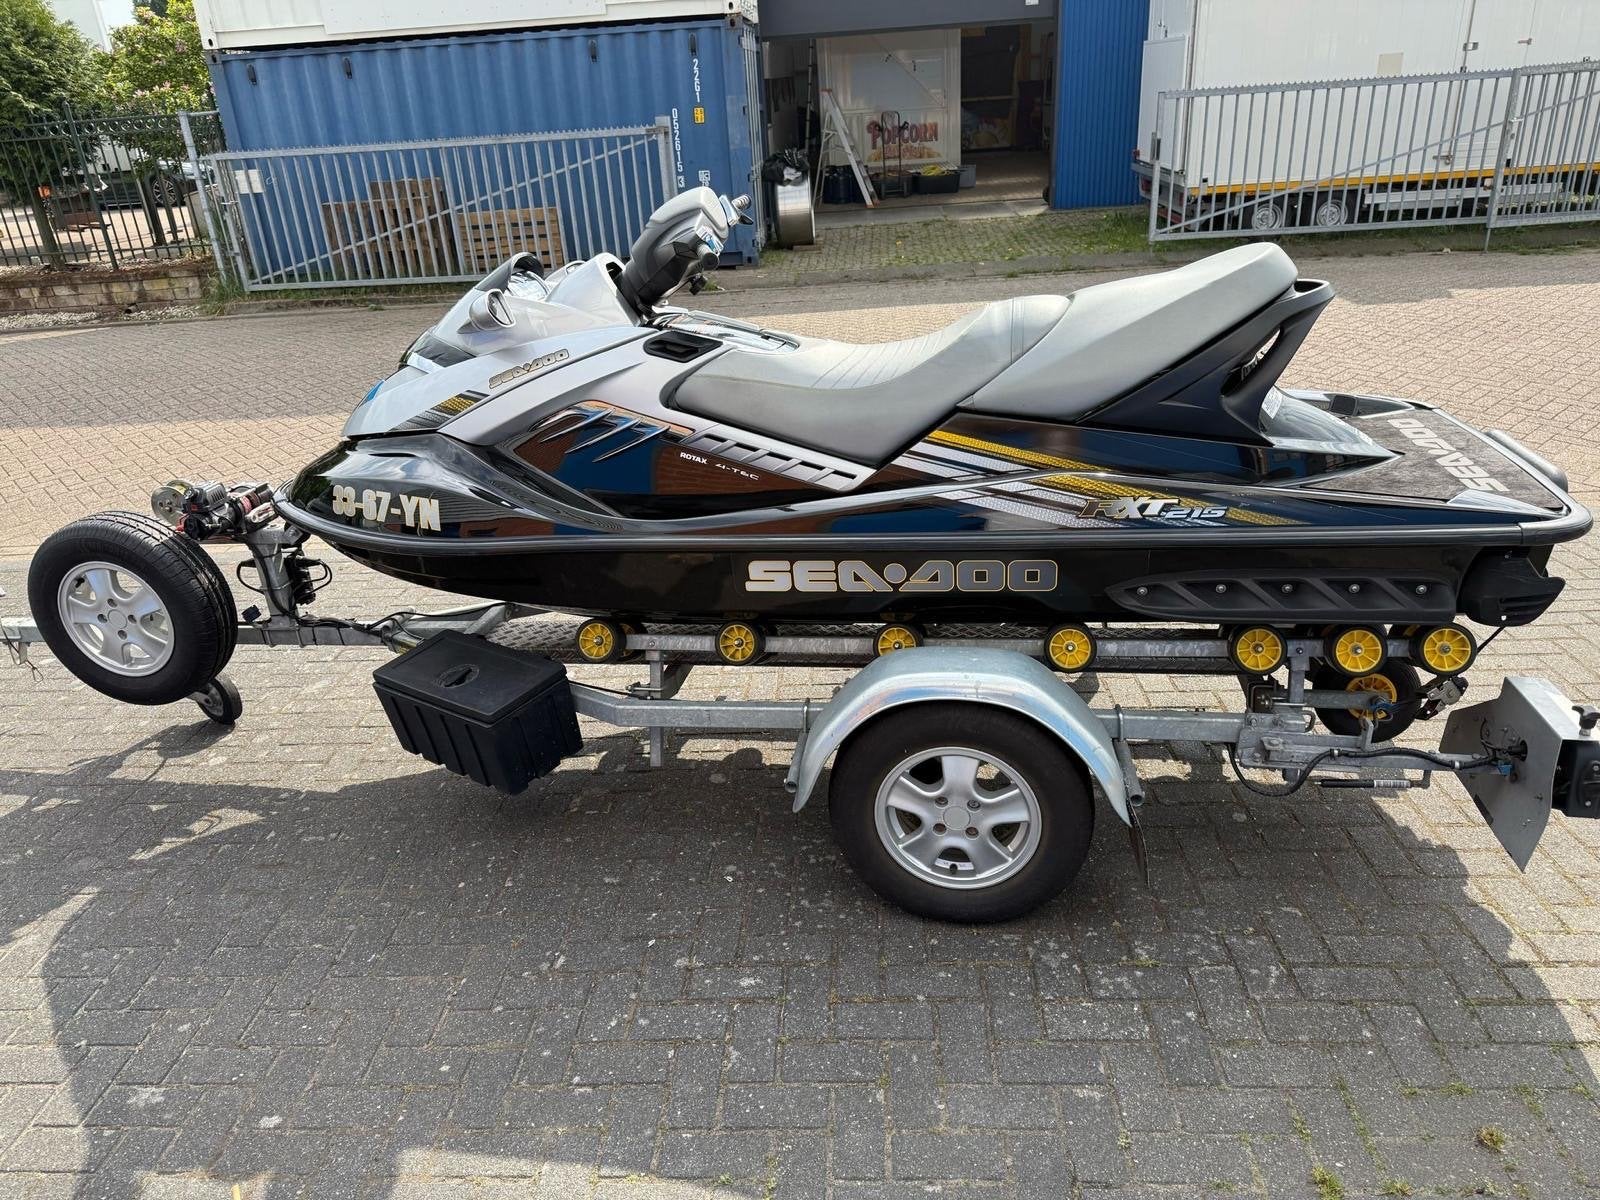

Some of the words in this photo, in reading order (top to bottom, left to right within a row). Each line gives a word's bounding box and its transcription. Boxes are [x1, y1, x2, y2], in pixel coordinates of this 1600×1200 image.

[671, 107, 684, 172] 052615
[680, 451, 708, 465] ROTAX
[715, 463, 760, 481] 4-TEC
[332, 484, 441, 532] 33-67-YN
